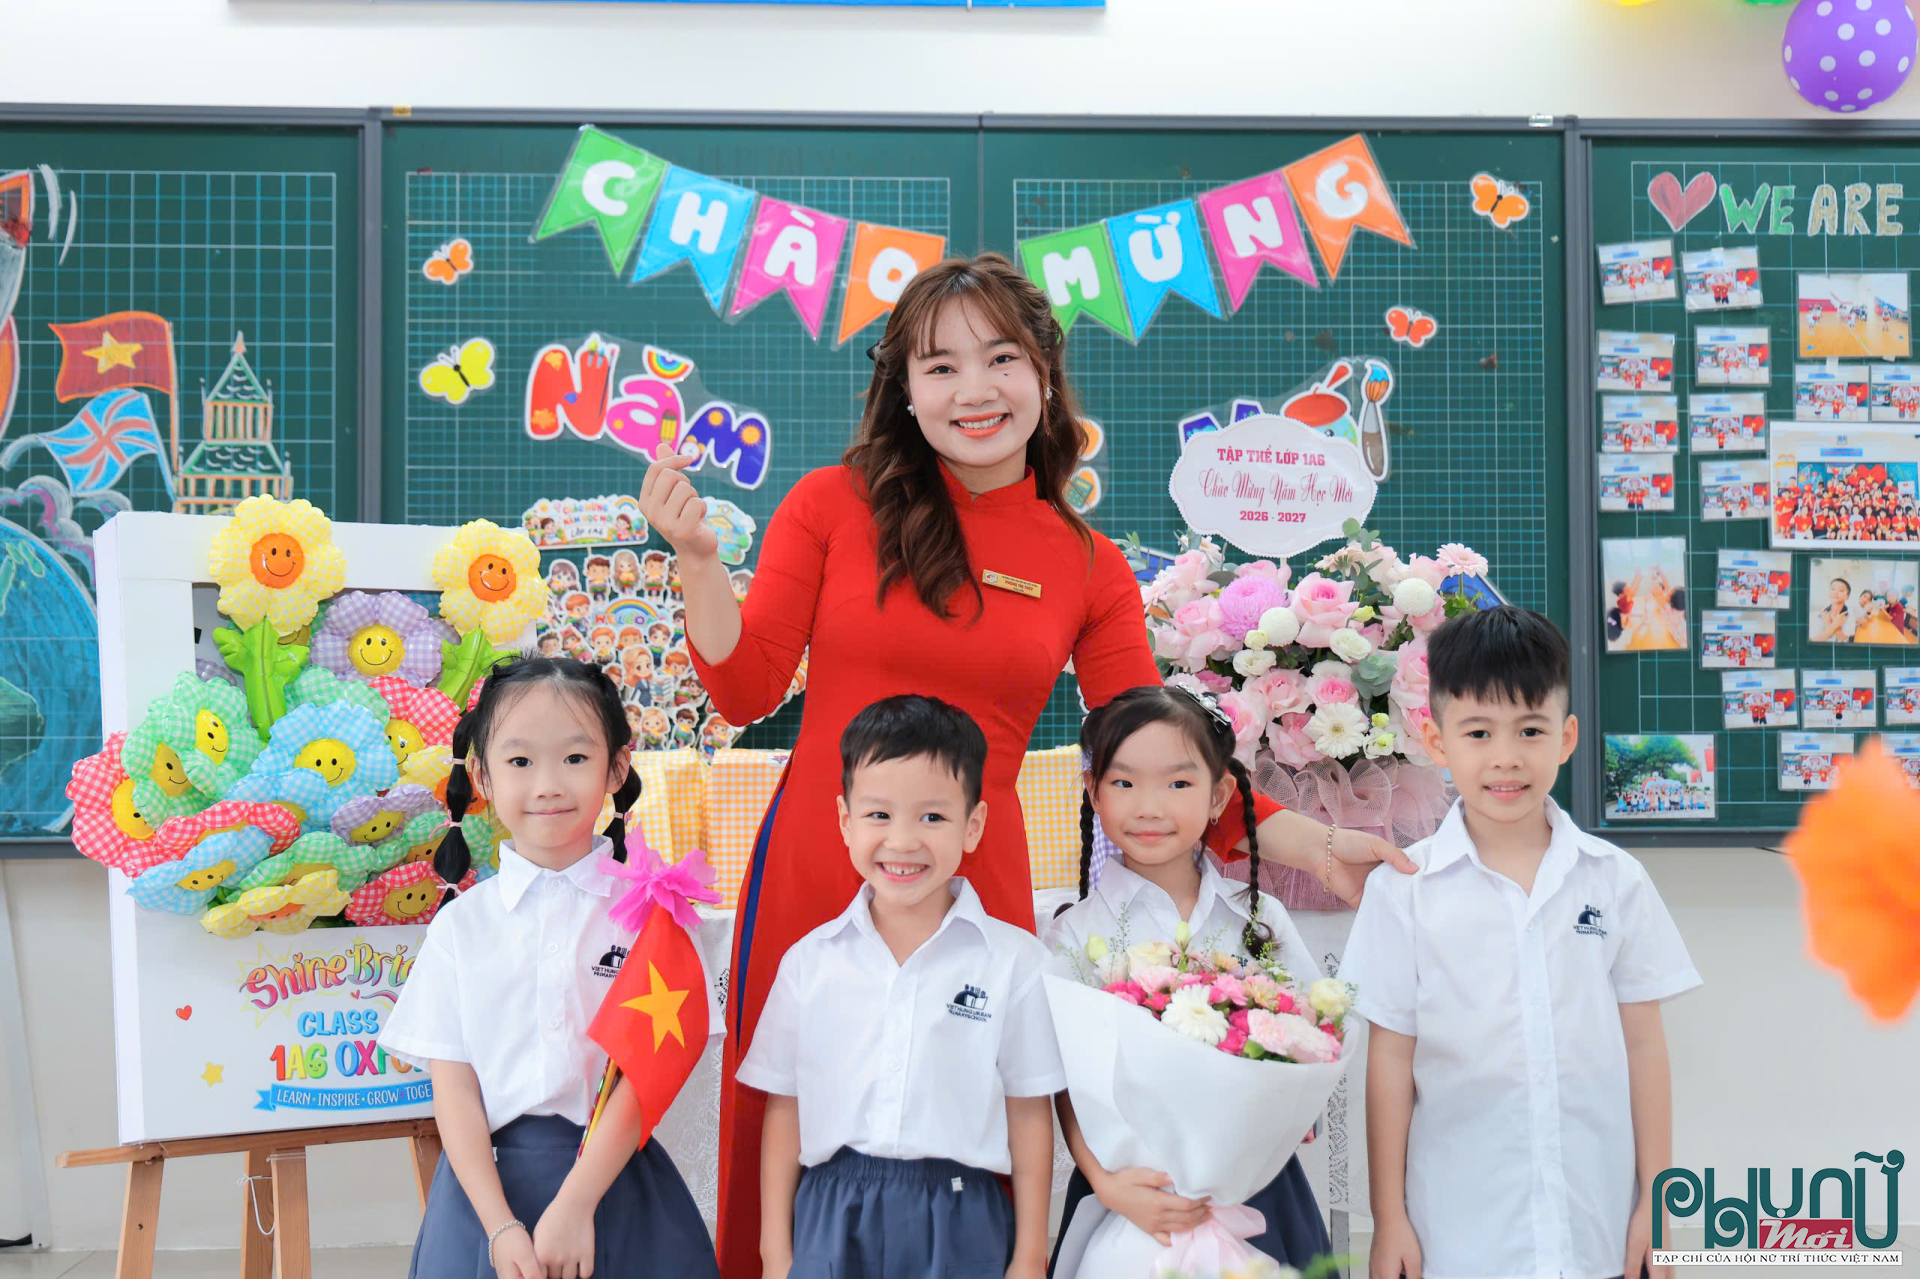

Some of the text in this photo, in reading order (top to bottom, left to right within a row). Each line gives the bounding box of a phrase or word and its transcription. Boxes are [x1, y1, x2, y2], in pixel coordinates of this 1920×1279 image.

[1719, 182, 1904, 236] WE ARE
[582, 160, 1368, 306] CHÀO MỪNG
[1217, 444, 1325, 466] TẬP THỂ LỚP 1A6
[1232, 471, 1265, 508] Mừng
[1270, 473, 1296, 505] Năm
[1300, 473, 1326, 506] Học
[1240, 511, 1268, 521] 2026
[1277, 512, 1306, 523] 2027
[239, 952, 347, 1009] Shine
[298, 1009, 379, 1037] CLASS
[270, 1043, 328, 1081] 1A6
[276, 1088, 312, 1105] LEARN
[317, 1091, 361, 1107] INSPIRE
[366, 1089, 399, 1106] GROW
